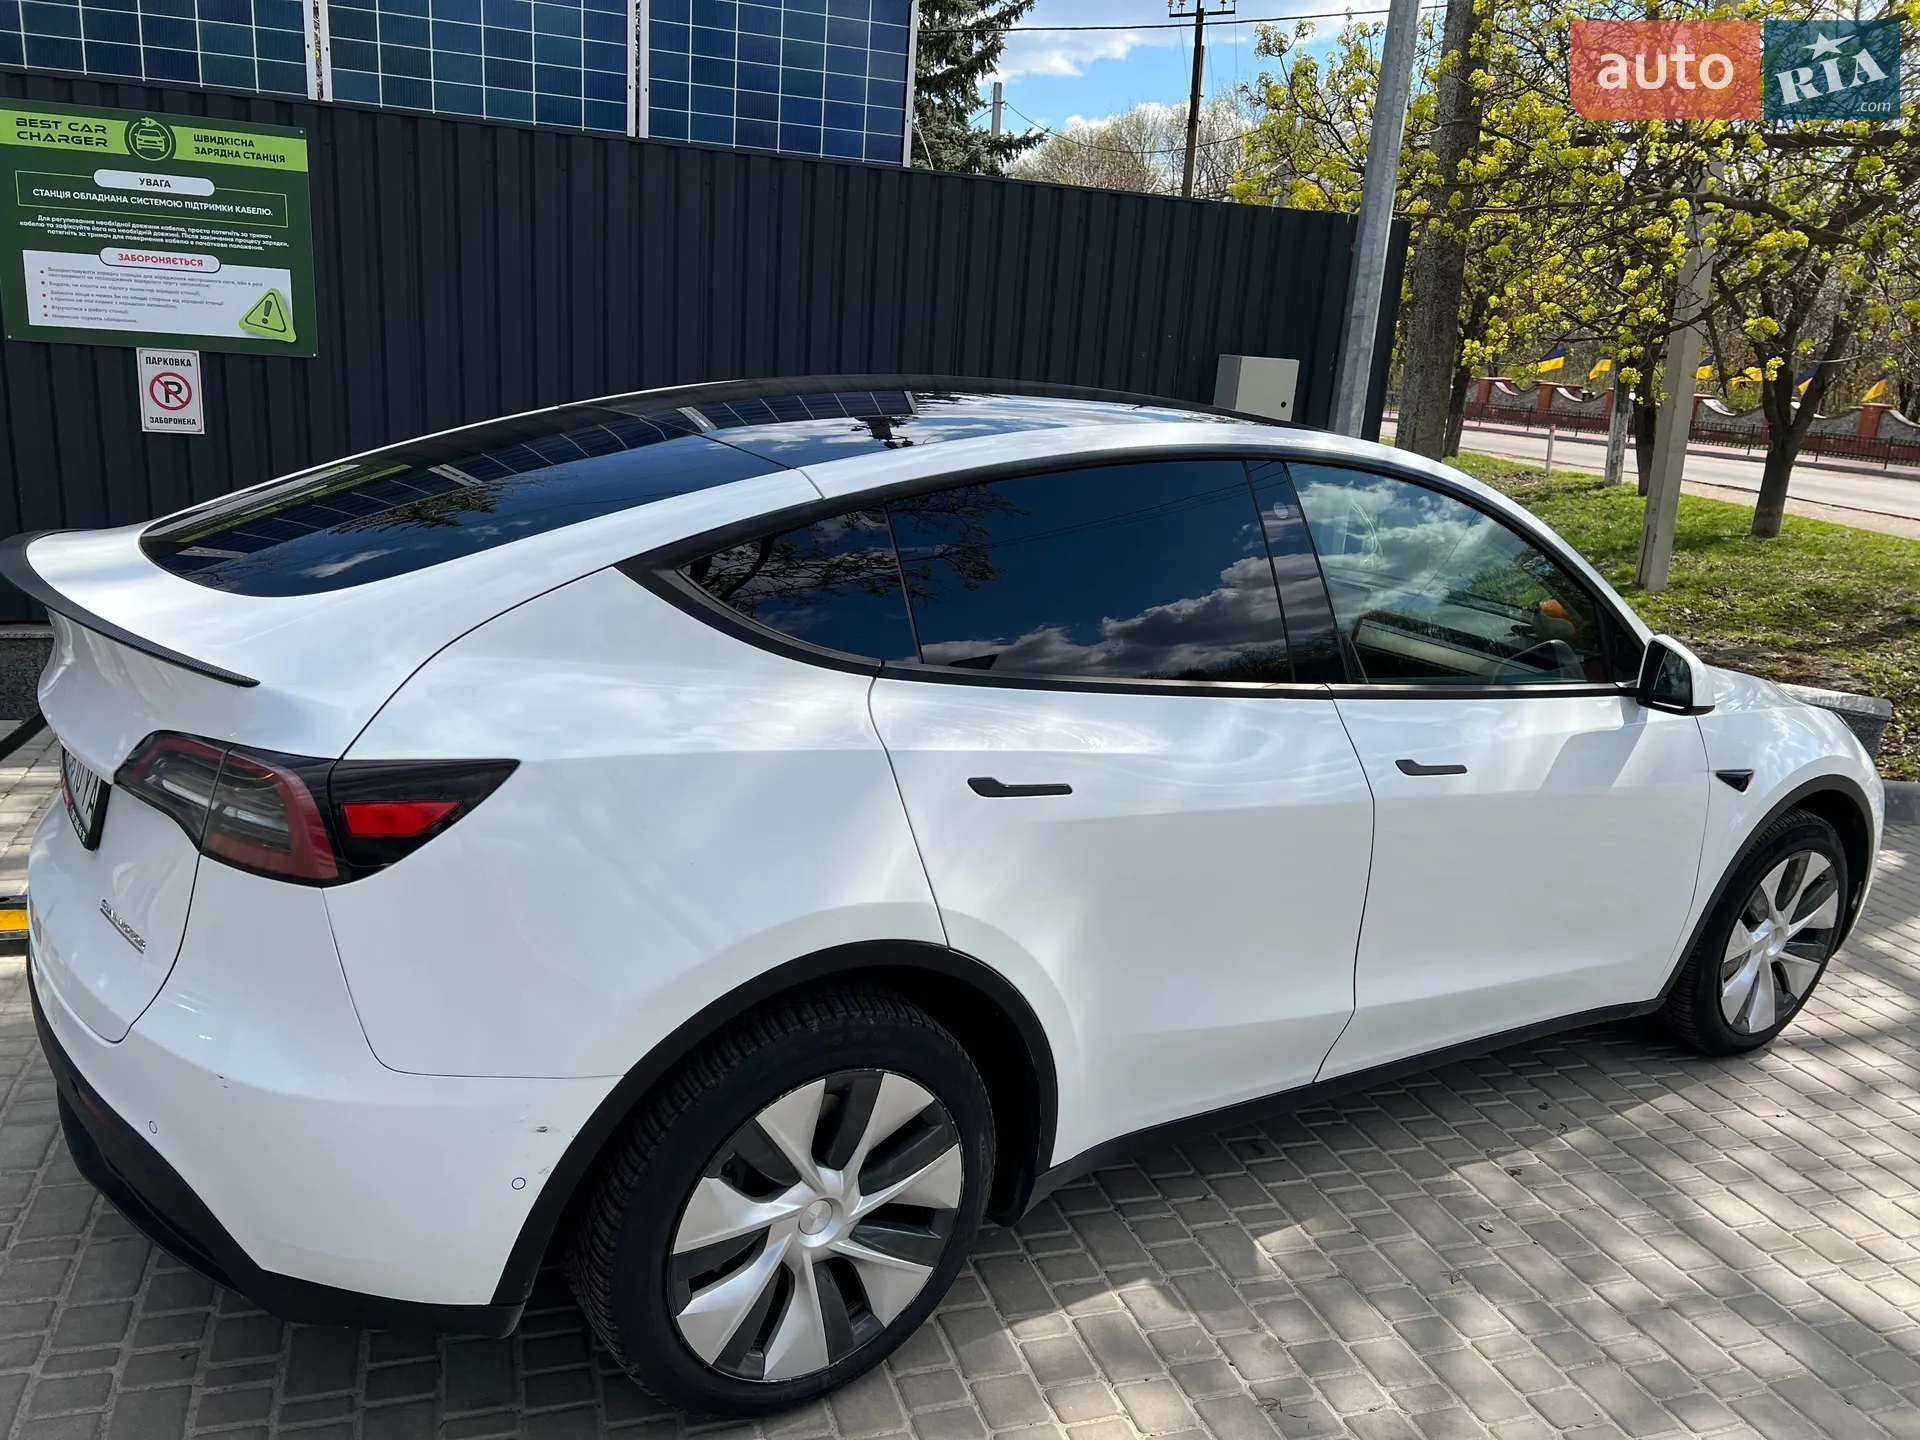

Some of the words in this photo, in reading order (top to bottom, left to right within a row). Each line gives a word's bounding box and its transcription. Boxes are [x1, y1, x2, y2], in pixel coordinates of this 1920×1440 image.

[16, 117, 62, 130] BEST
[68, 122, 107, 134] CAR
[16, 131, 108, 147] CHARGER
[193, 134, 255, 148] ШВИДКІСНА
[194, 147, 241, 159] ЗАРЯДНА
[243, 151, 286, 163] СТАНЦІЯ
[139, 177, 171, 188] УВАГА
[32, 188, 71, 199] СТАНЦІЯ
[73, 191, 129, 204] ОБЛАДНАНА
[130, 196, 183, 208] СИСТЕМОЮ
[185, 201, 234, 213] ПІДТРИМКИ
[235, 205, 273, 216] КАБЕЛЮ.
[118, 254, 203, 266] ЗАБОРОНЯЄТЬСЯ
[145, 356, 192, 367] ПАРКОВКА
[150, 416, 196, 425] ЗАБОРОНЕНА
